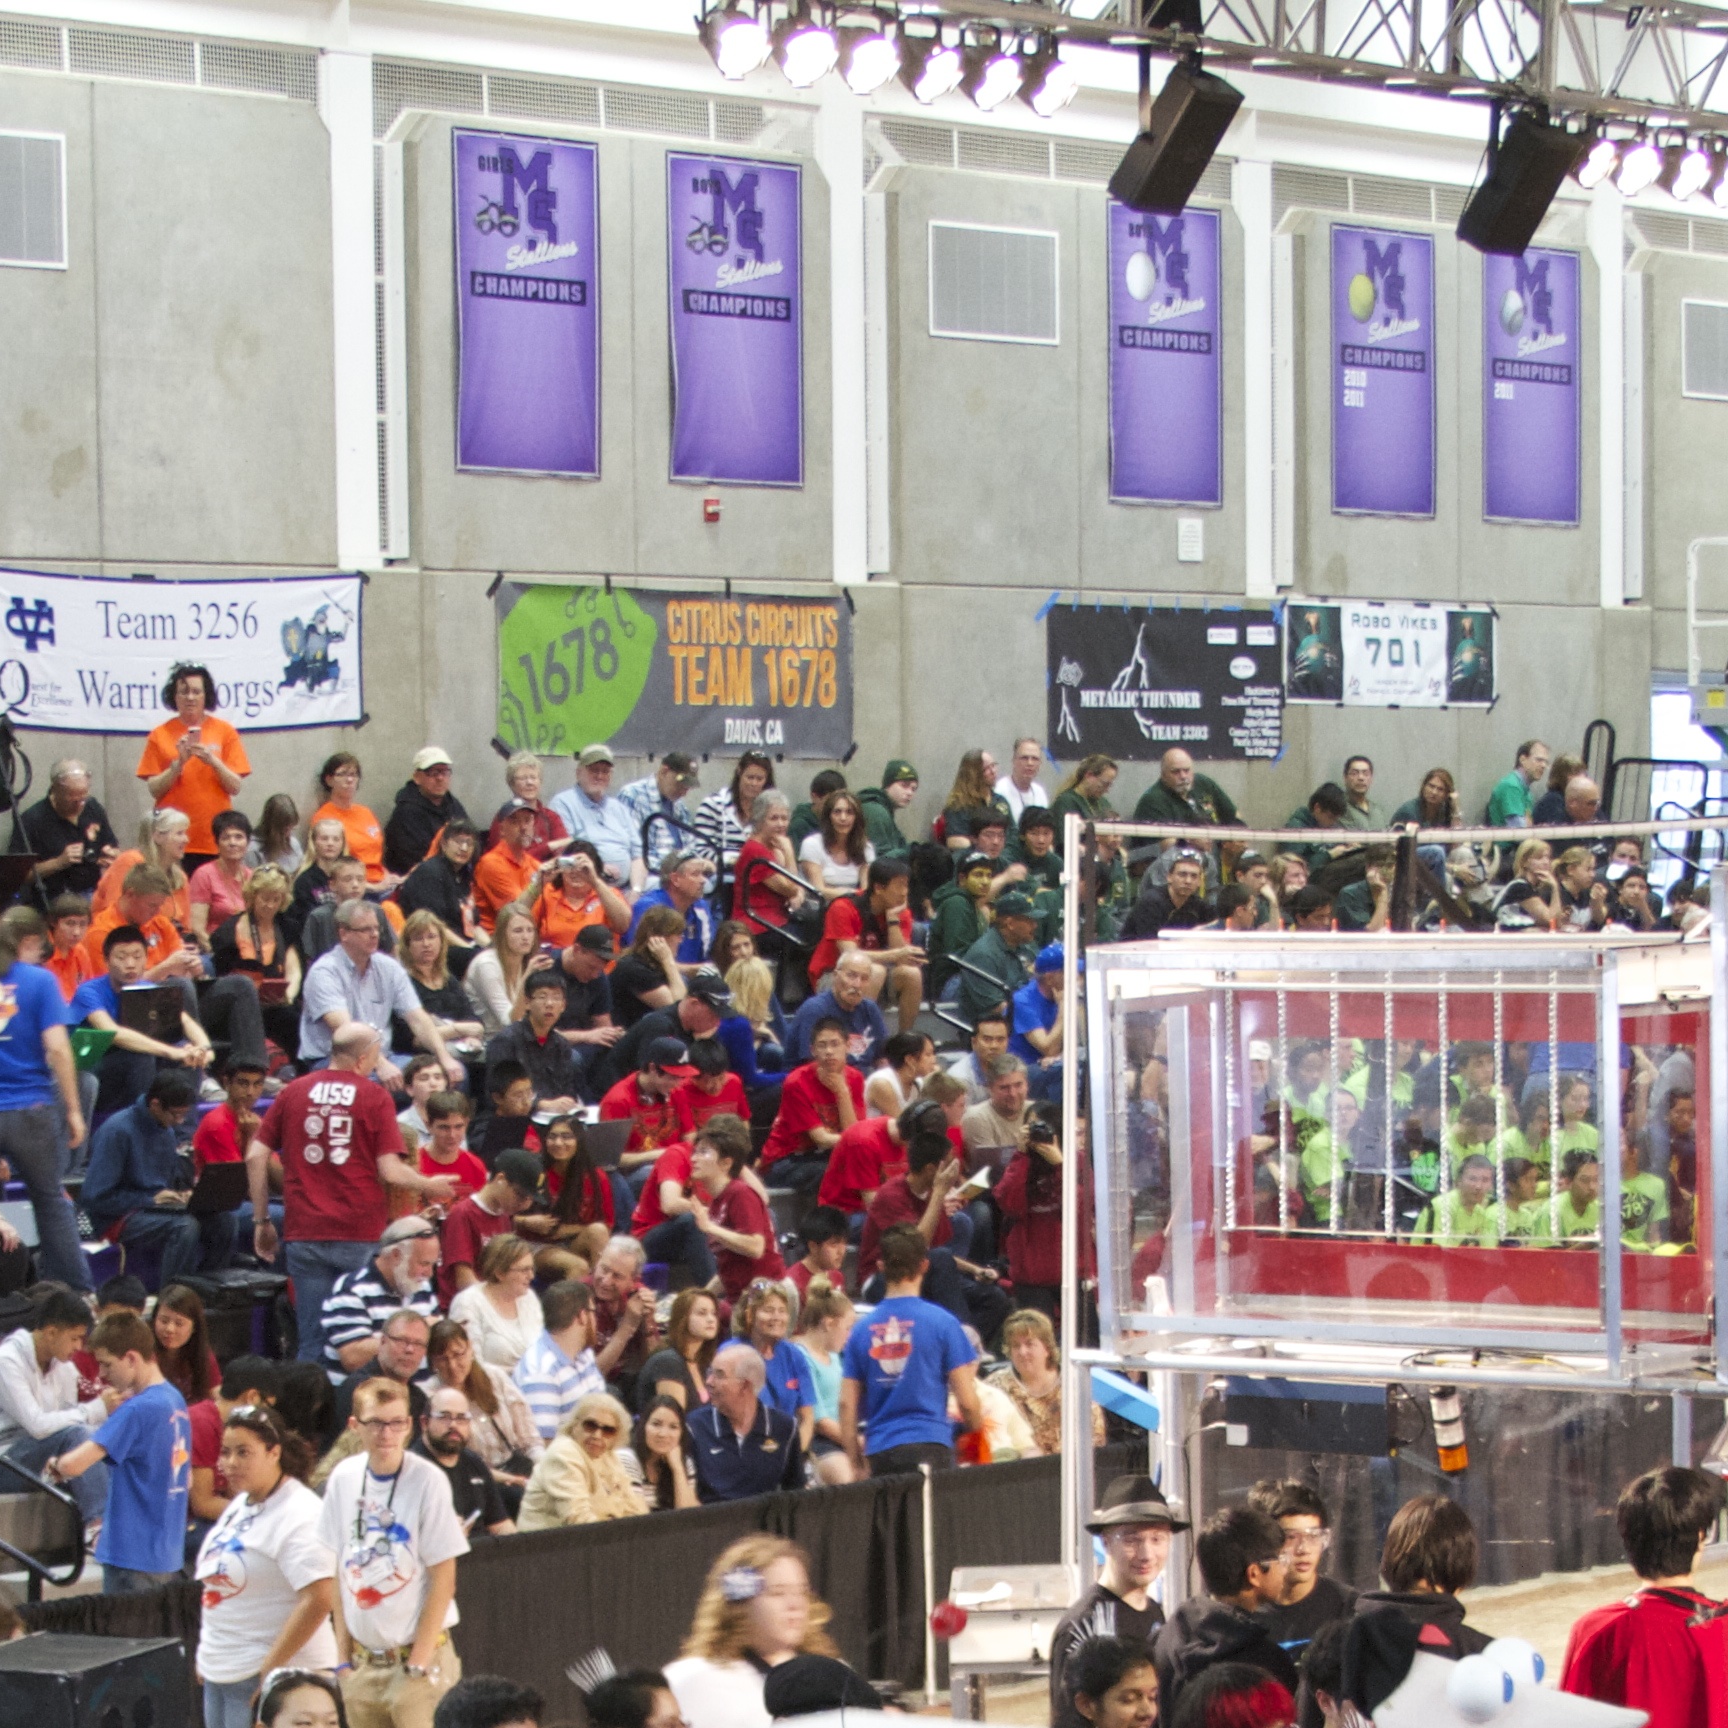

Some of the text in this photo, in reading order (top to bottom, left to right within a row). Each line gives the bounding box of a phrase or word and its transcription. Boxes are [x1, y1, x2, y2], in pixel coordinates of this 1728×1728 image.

[506, 240, 578, 271] Stallions
[715, 260, 784, 288] Stallions
[474, 274, 582, 303] CHAMPIONS
[687, 294, 788, 319] CHAMPIONS
[1123, 329, 1209, 350] CHAMPIONS
[1343, 349, 1421, 369] CHAMPIONS
[1494, 361, 1569, 382] CHAMPIONS
[1343, 389, 1365, 407] 2011
[1494, 382, 1514, 399] 2011
[96, 600, 258, 641] Team 3256
[667, 600, 838, 648] CITRUS CIRCUITS
[1365, 637, 1421, 667] 701
[518, 617, 619, 714] 1678
[668, 645, 837, 708] TEAM 1678
[1080, 690, 1201, 708] METALLIC THUNDER
[724, 718, 784, 746] DAVIS, CA
[1151, 725, 1180, 740] TEAM
[308, 1082, 357, 1106] 4159
